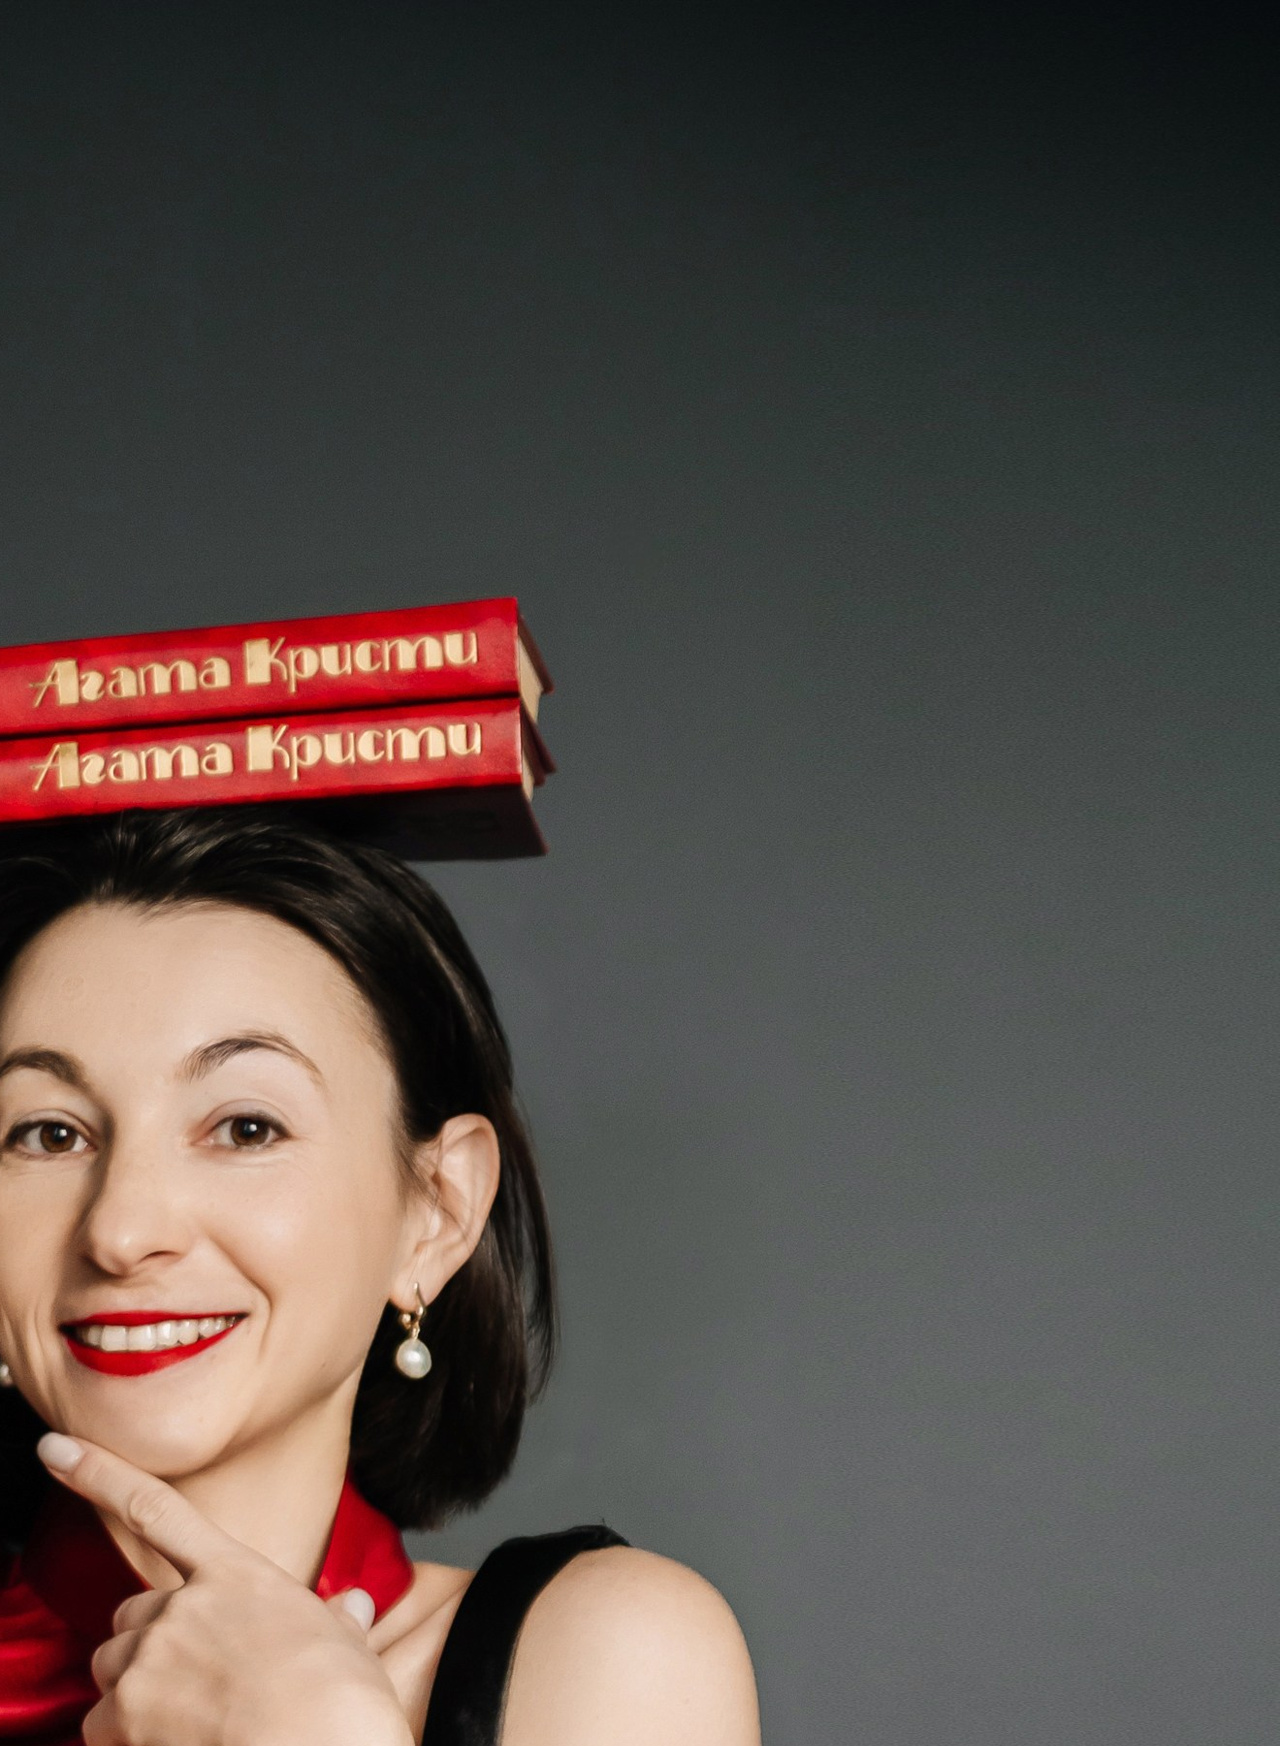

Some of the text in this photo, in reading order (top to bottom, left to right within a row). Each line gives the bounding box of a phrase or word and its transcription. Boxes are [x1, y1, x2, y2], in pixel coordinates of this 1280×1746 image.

[29, 631, 478, 708] Агата Кристи
[29, 722, 482, 792] Агата Кристи
